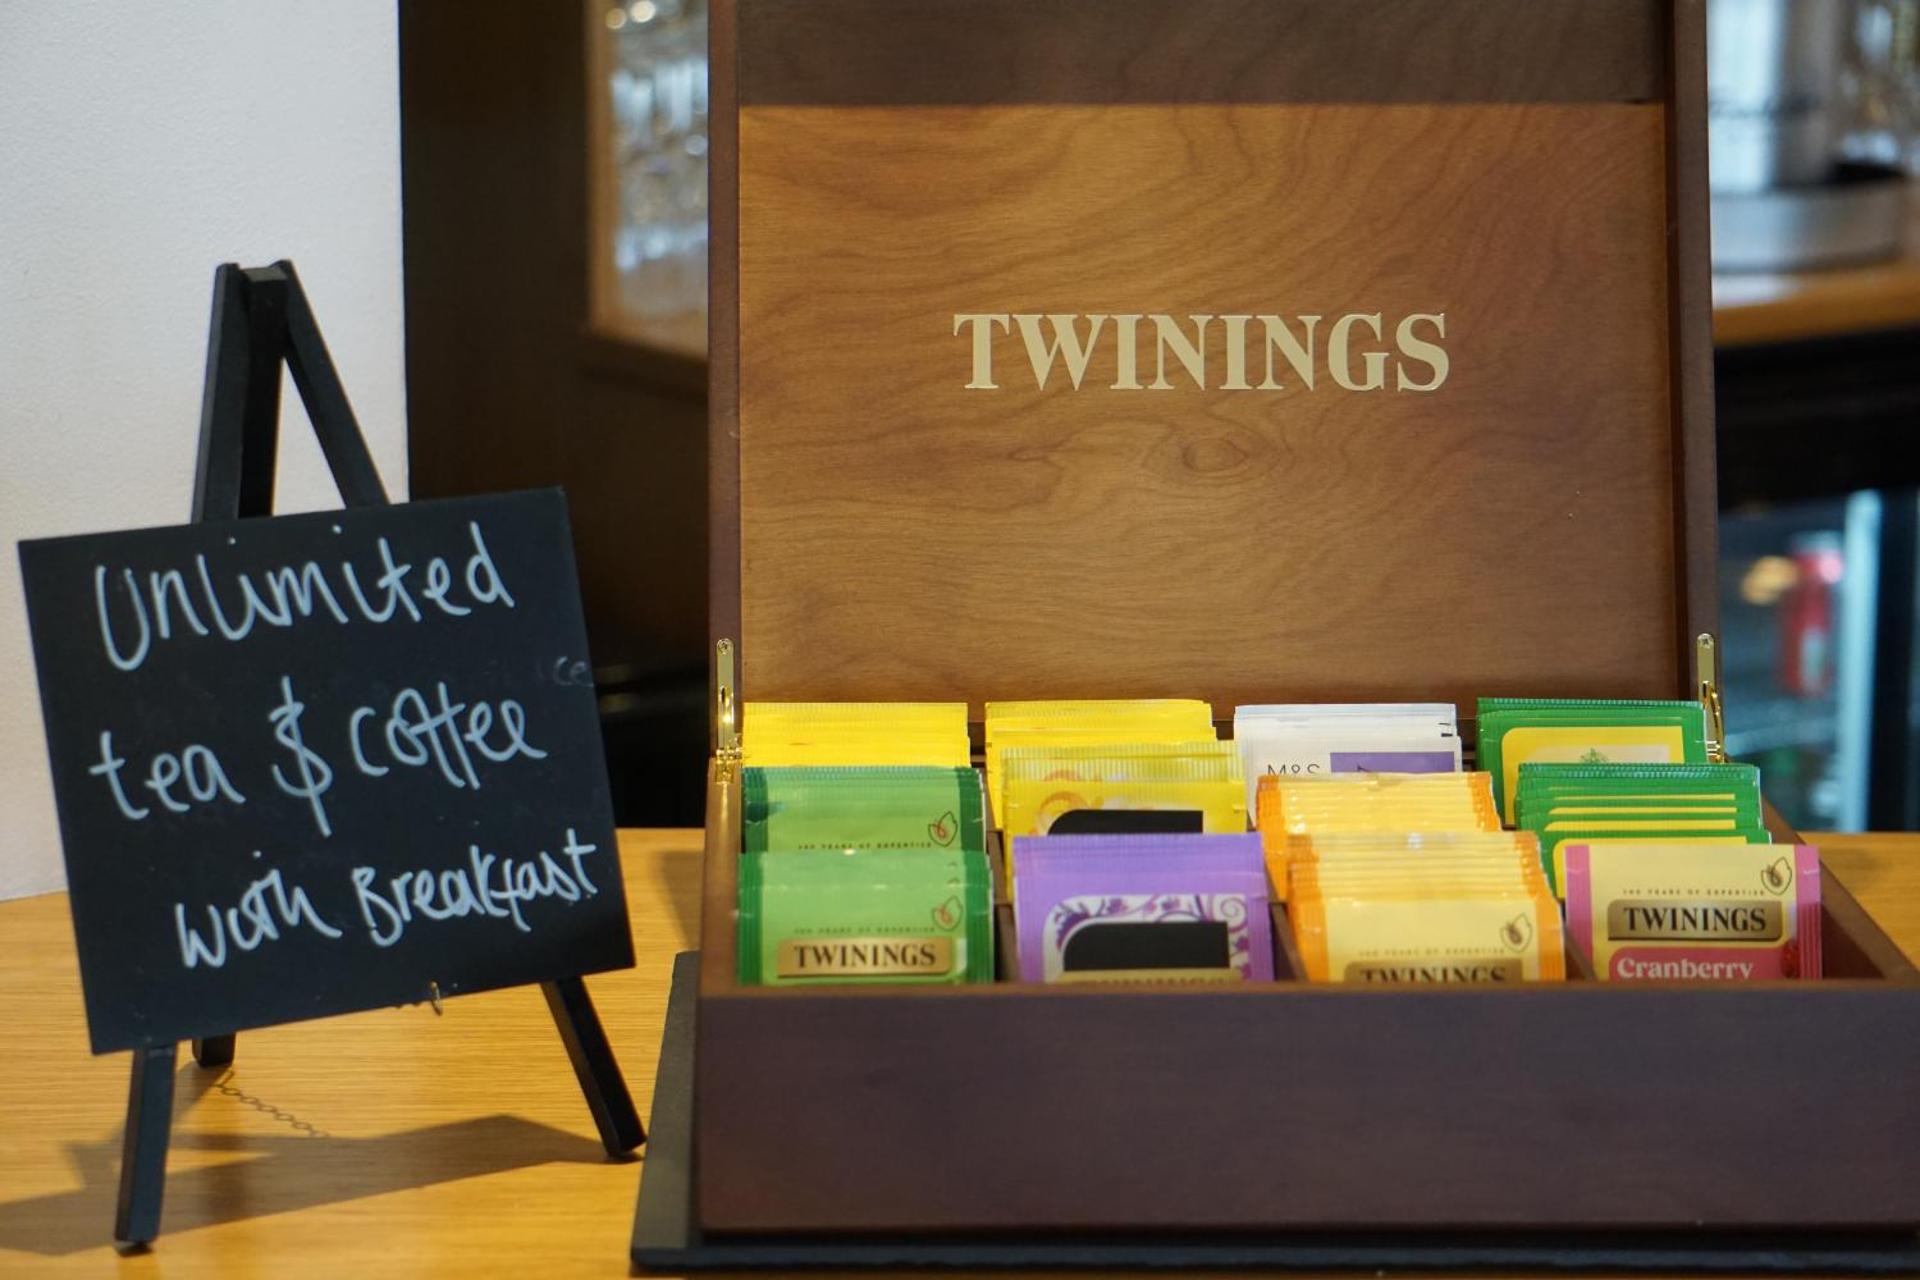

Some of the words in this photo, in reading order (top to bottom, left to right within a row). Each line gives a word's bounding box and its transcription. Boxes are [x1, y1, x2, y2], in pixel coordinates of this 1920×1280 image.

[953, 312, 1450, 392] TWININGS
[95, 520, 516, 671] Unlimited
[90, 730, 246, 820] tea
[349, 681, 548, 790] coffee
[350, 828, 598, 947] Breakfast
[1623, 906, 1768, 933] TWININGS
[793, 943, 937, 969] TWININGS
[1616, 957, 1754, 981] Cranberry
